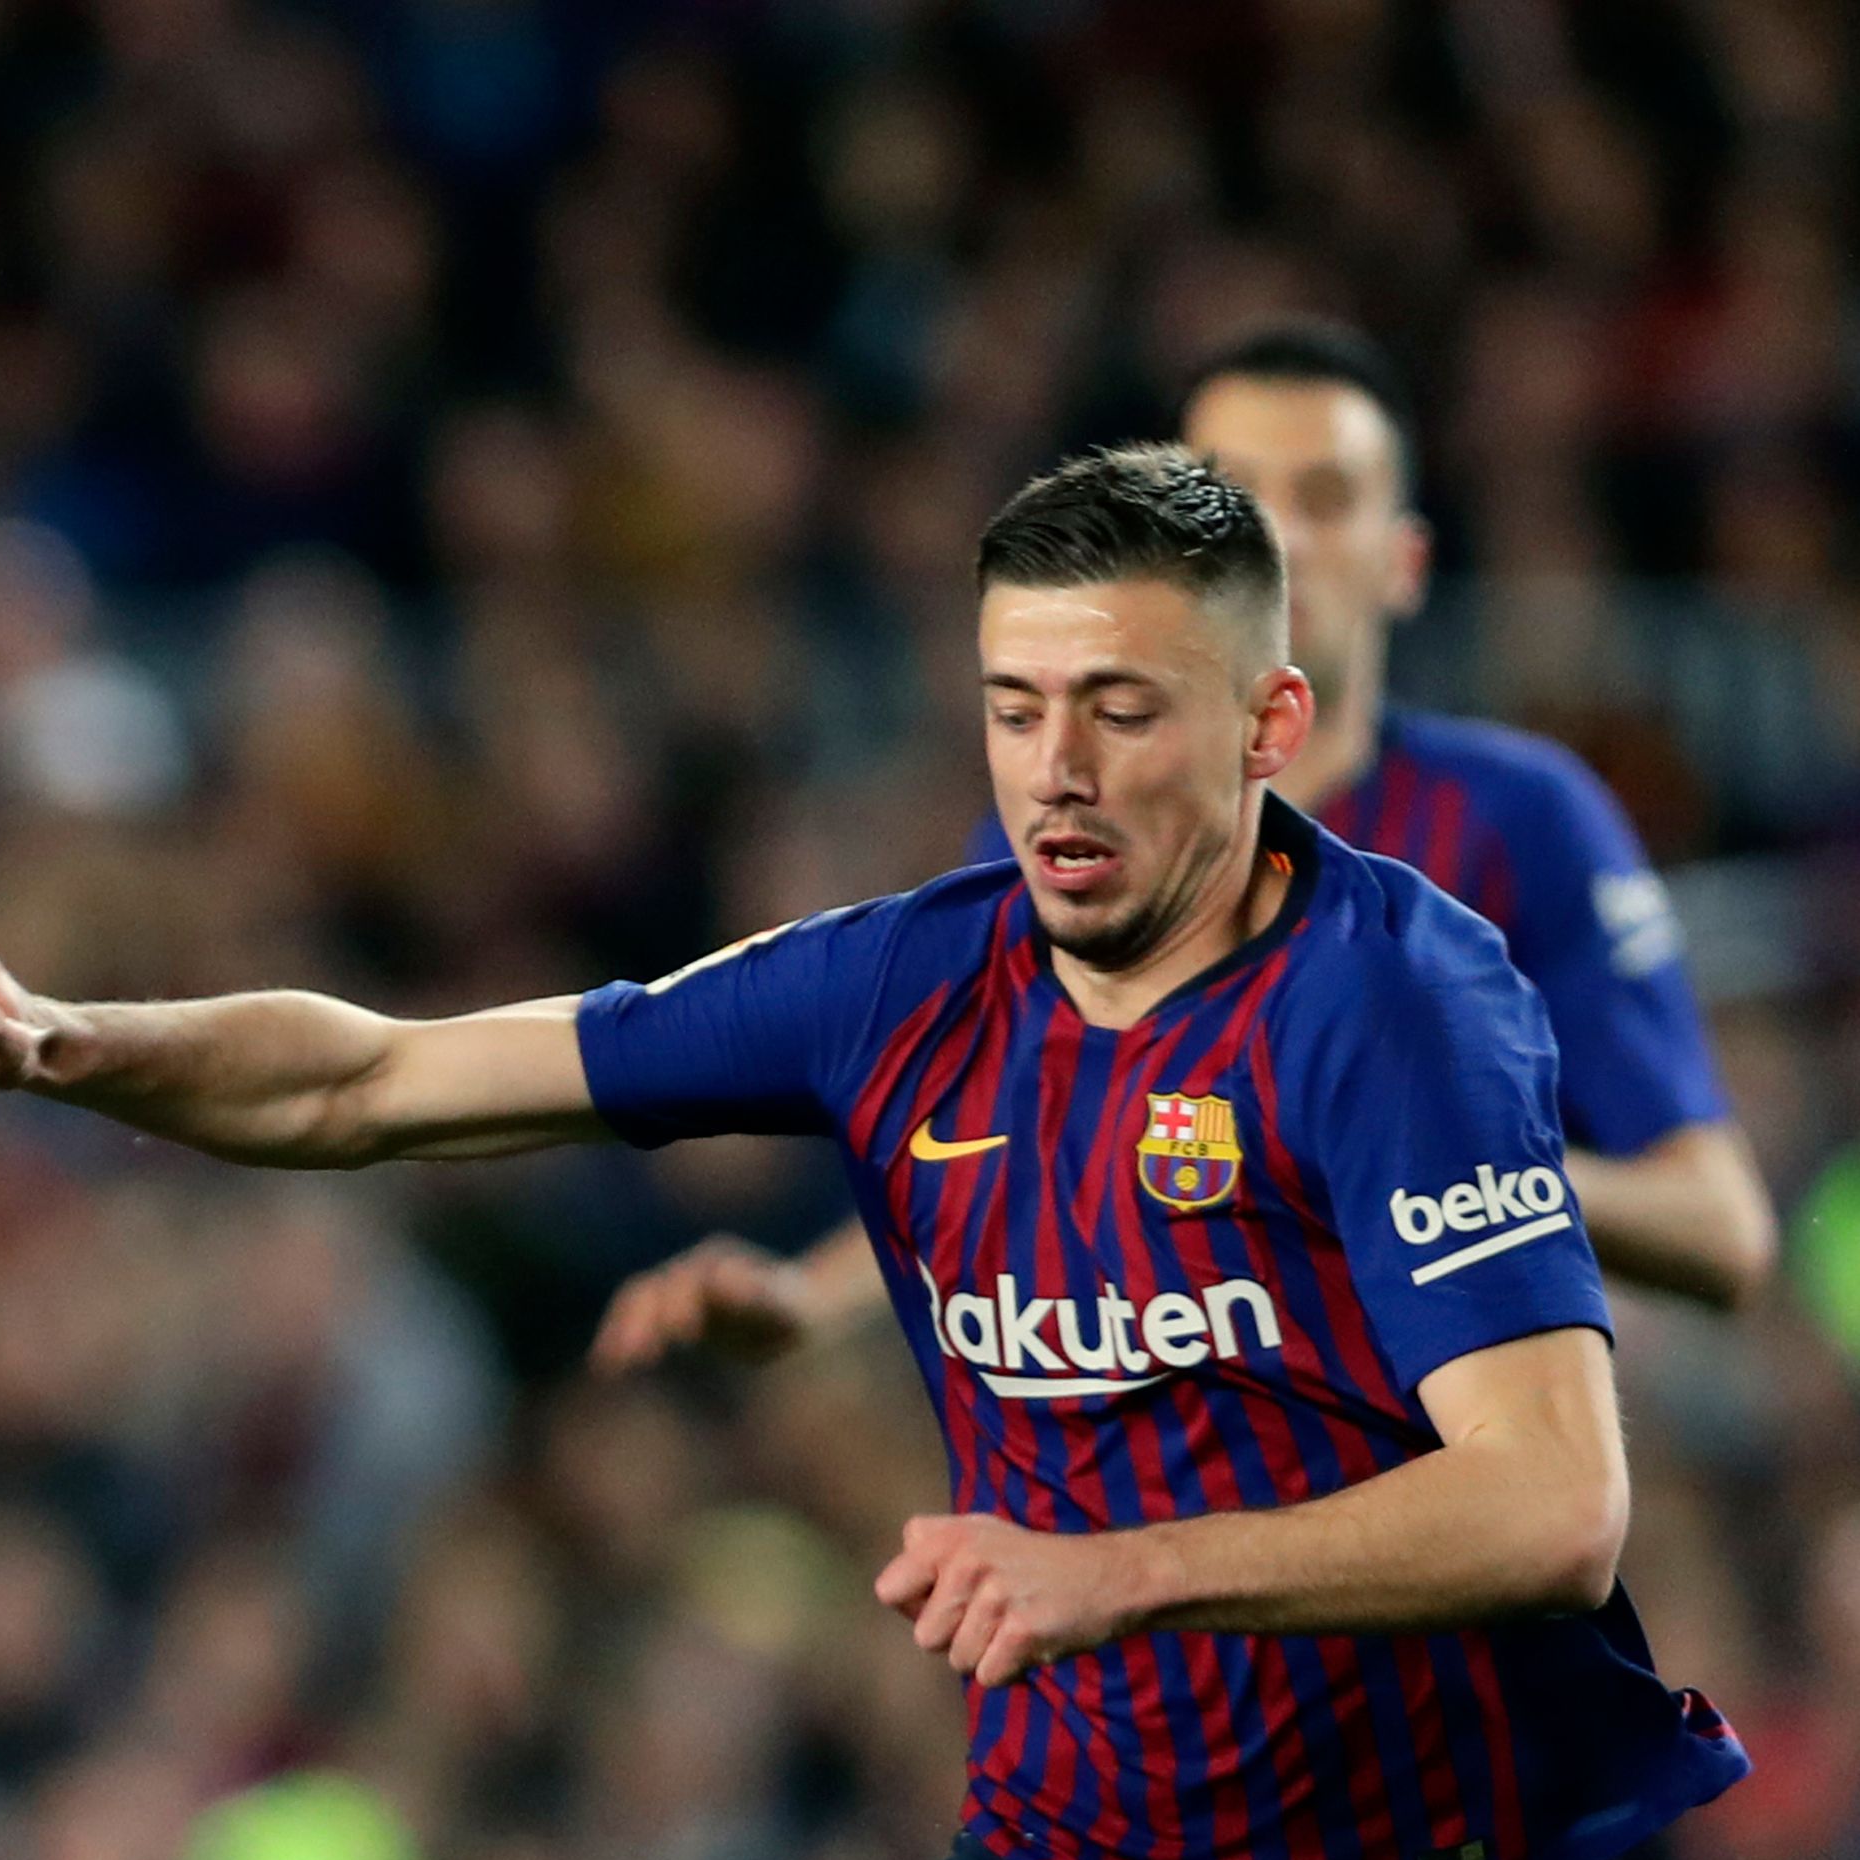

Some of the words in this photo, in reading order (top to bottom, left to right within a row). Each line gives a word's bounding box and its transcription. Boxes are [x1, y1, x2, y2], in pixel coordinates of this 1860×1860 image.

[1169, 1142, 1209, 1156] FCB
[1389, 1163, 1565, 1245] beko
[916, 1255, 1283, 1374] akuten
